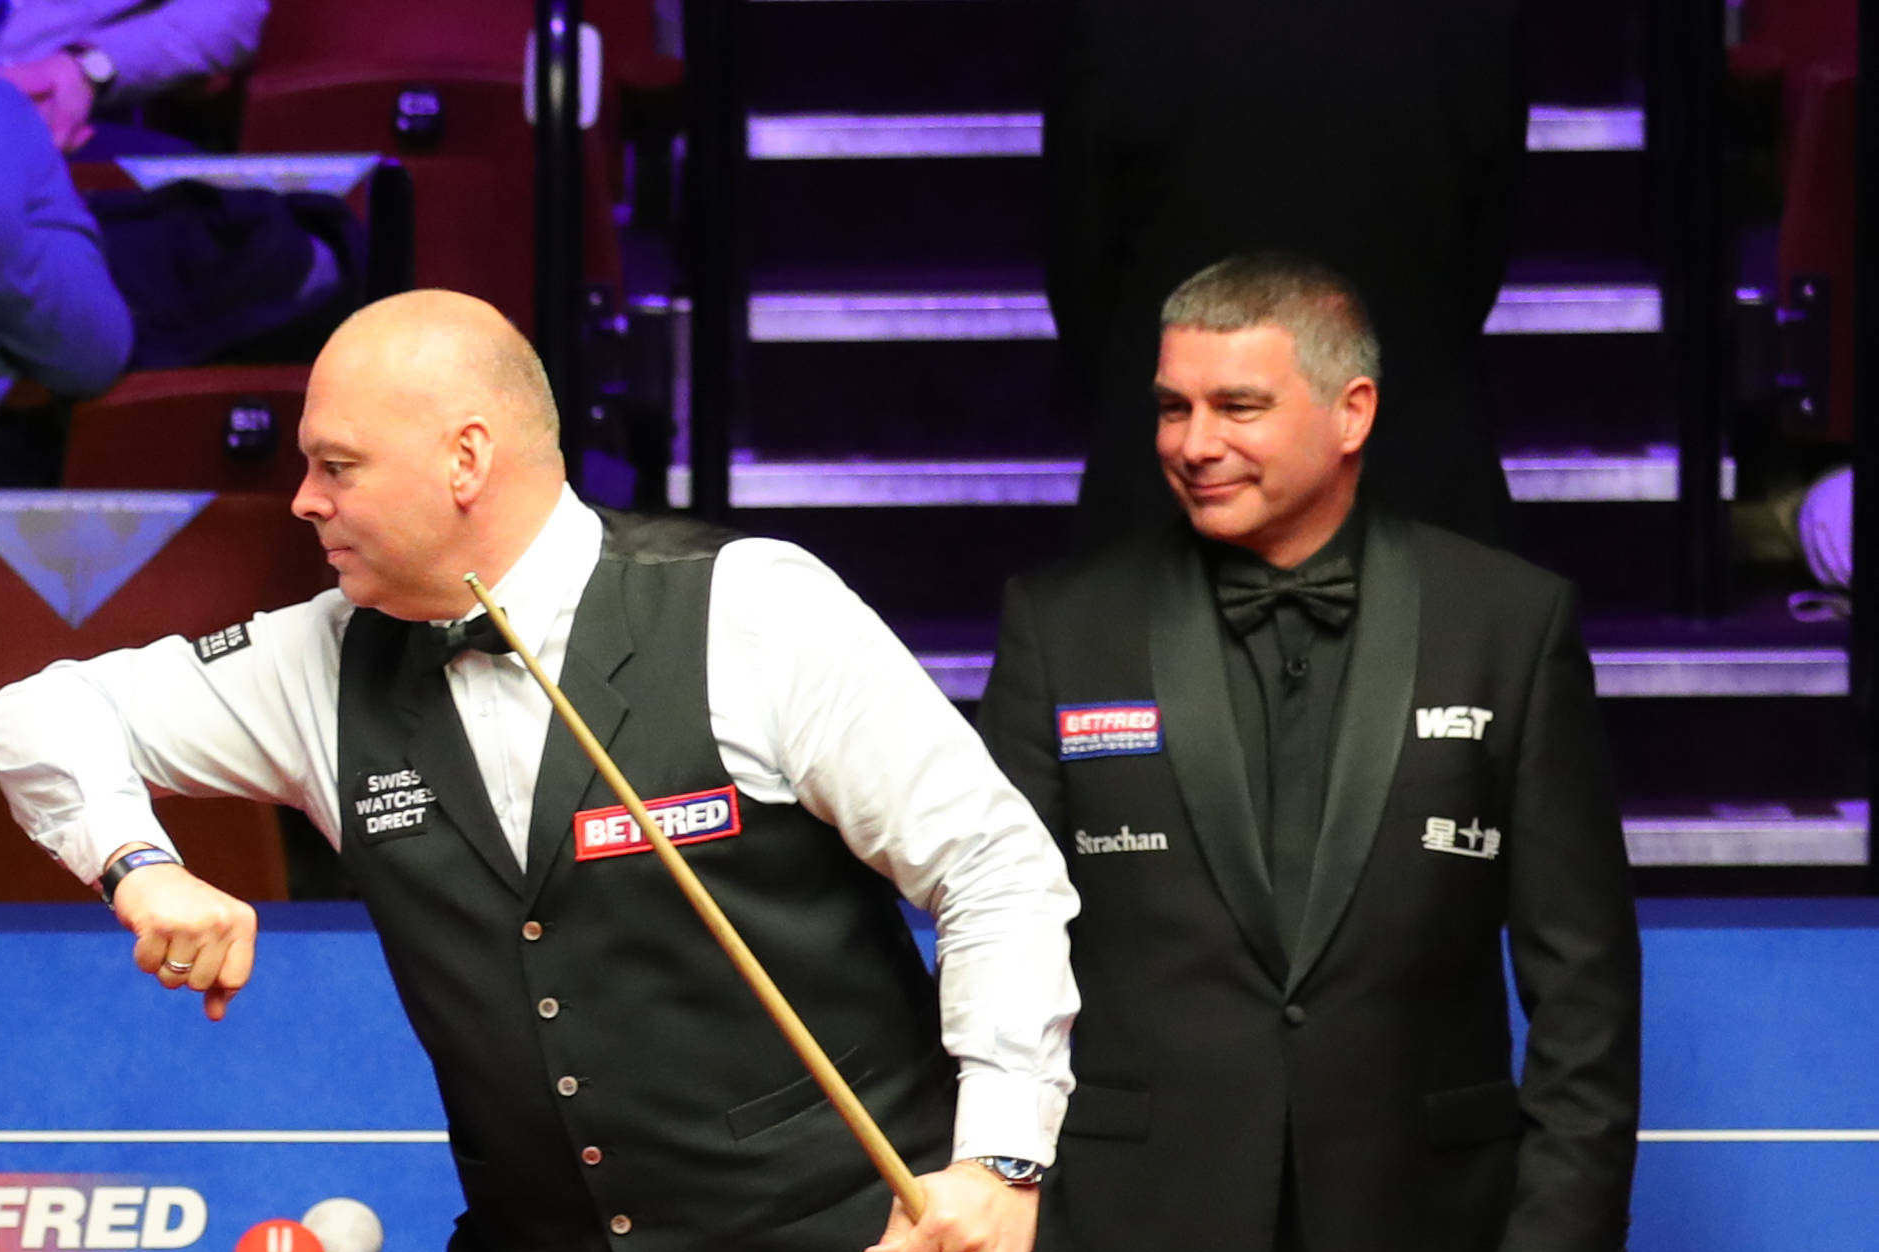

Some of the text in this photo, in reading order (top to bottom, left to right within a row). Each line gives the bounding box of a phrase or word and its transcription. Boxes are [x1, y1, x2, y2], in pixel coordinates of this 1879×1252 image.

[1066, 711, 1157, 733] BETFRED
[1415, 706, 1494, 740] WST
[367, 769, 422, 793] SWISS
[366, 807, 426, 834] DIRECT
[1075, 824, 1169, 855] Strachan
